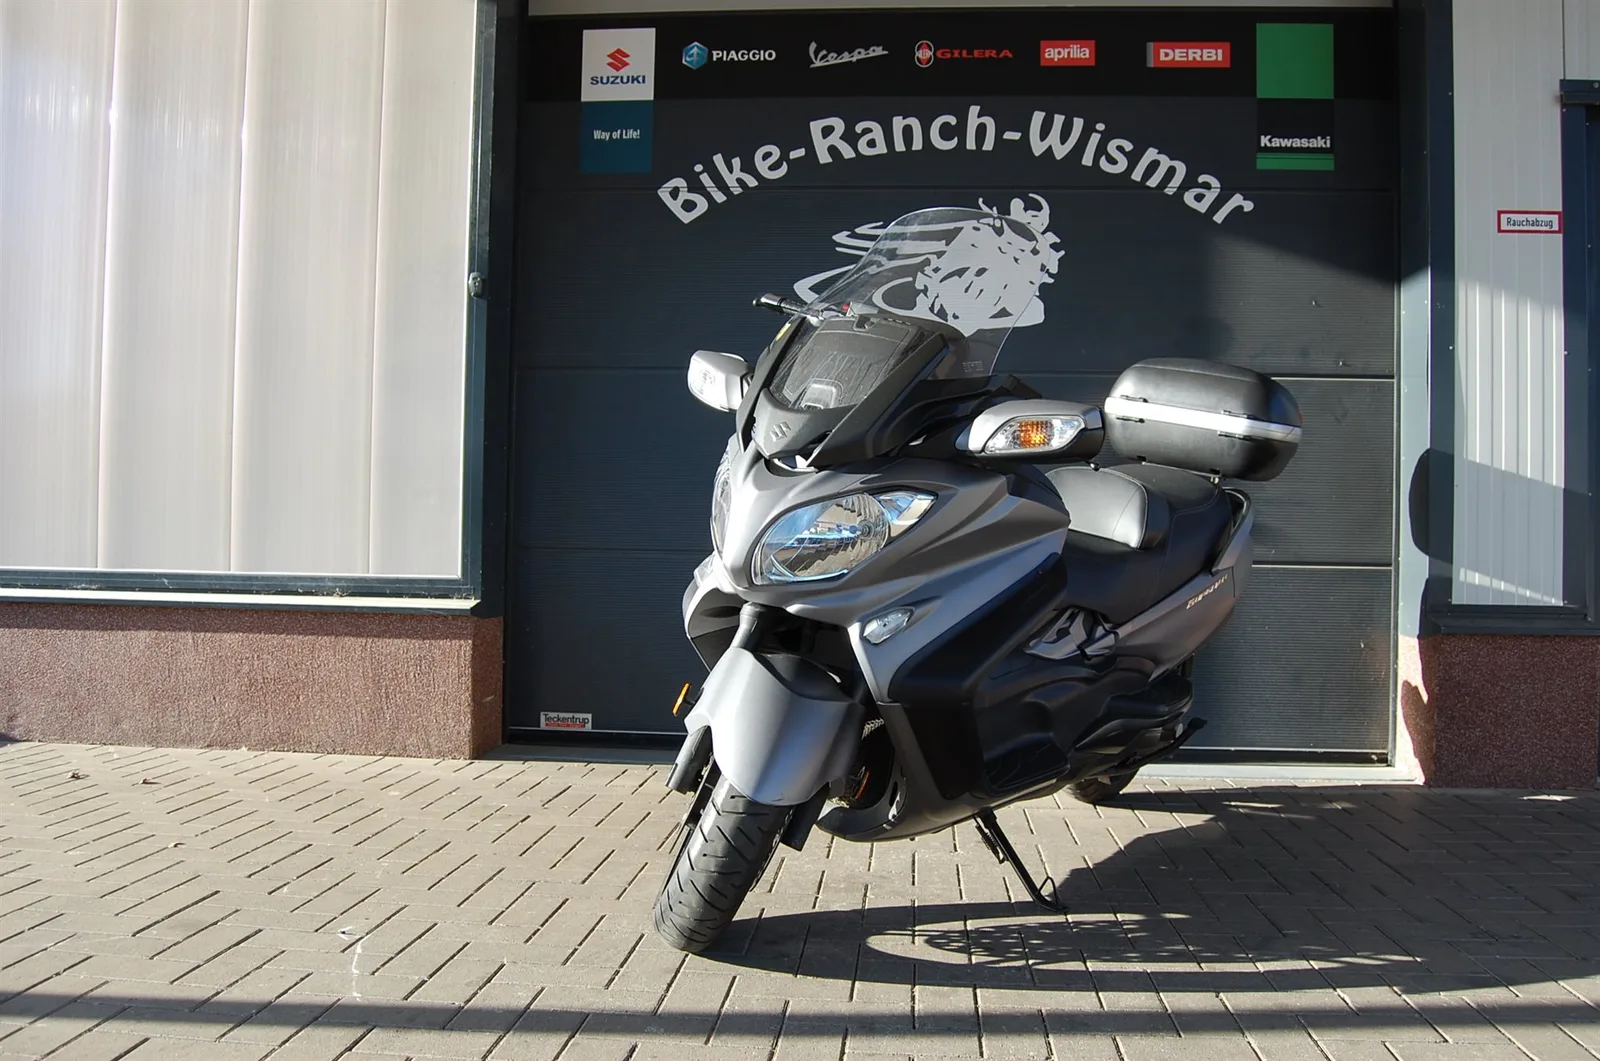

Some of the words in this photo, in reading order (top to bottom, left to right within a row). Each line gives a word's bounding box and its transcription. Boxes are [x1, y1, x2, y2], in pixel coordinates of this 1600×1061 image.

[712, 49, 776, 62] PIAGGIO
[809, 41, 889, 68] Vespa
[936, 49, 1013, 59] GILERA
[1044, 44, 1090, 62] aprilia
[1159, 48, 1223, 62] DERBI
[590, 74, 646, 86] SUZUKI
[593, 130, 611, 141] Way
[612, 129, 622, 140] of
[622, 129, 641, 140] Life!
[1260, 135, 1331, 148] Kawasaki
[657, 105, 1255, 225] Bike-Ranch-Wismar
[1506, 216, 1553, 230] Rauchabzug
[542, 713, 590, 725] Teckentrup
